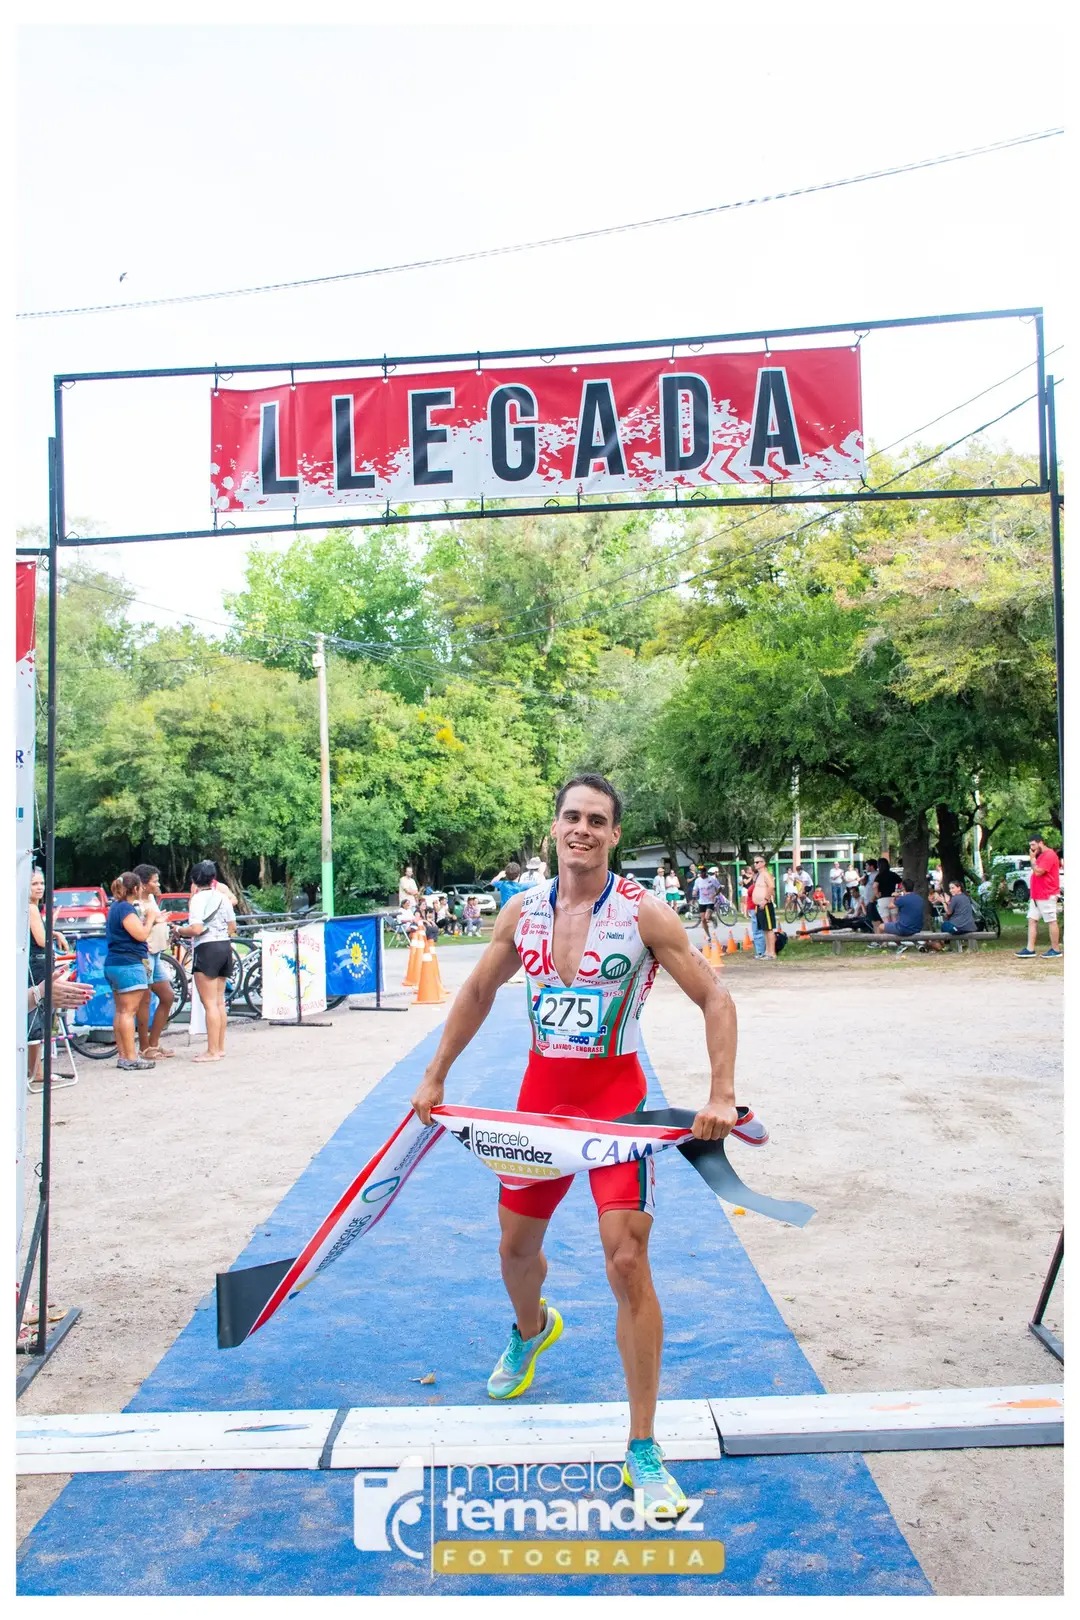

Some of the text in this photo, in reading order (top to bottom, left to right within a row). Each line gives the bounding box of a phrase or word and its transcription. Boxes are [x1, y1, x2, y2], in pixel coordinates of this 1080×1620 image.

[258, 366, 803, 496] LLEGADA
[605, 931, 625, 940] Nalini
[541, 997, 594, 1028] 275
[575, 1045, 604, 1054] ENGRASE
[475, 1130, 529, 1148] marcelo
[475, 1140, 554, 1165] fernandez
